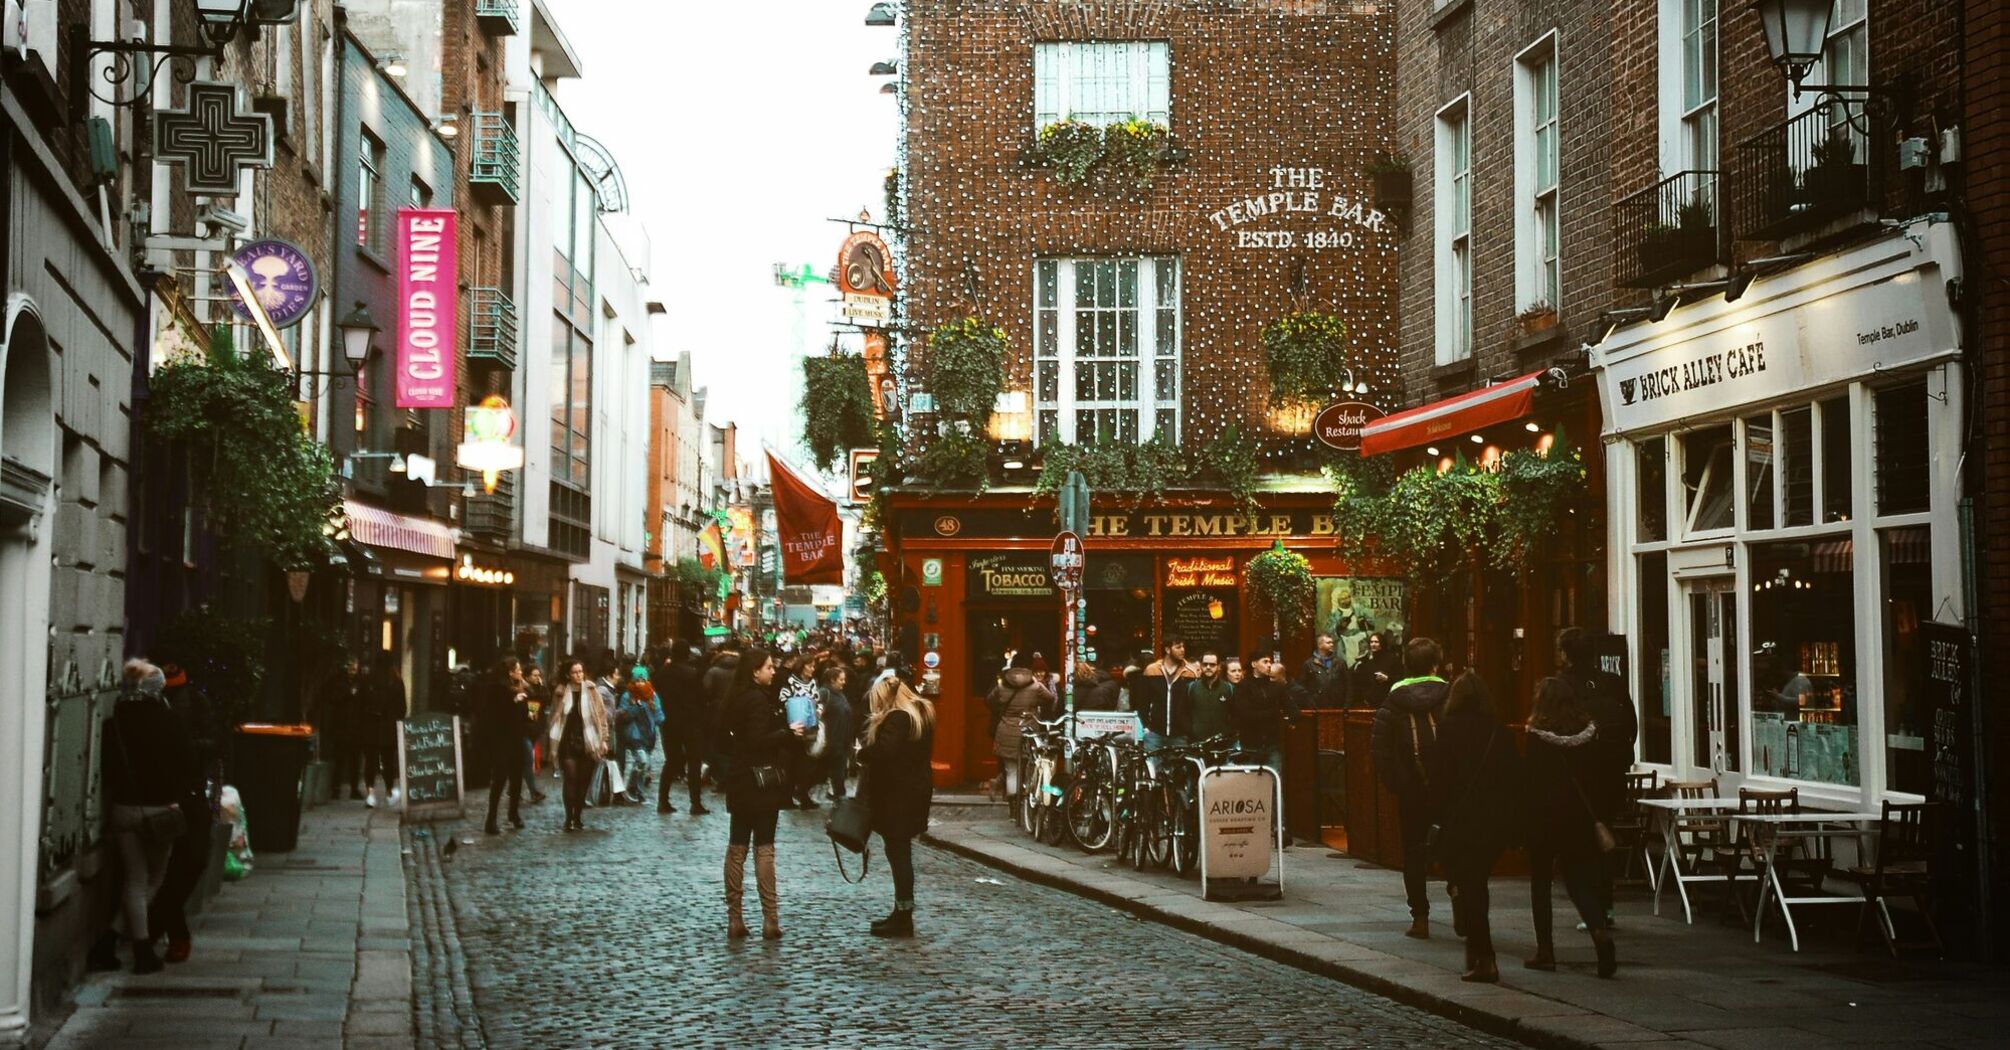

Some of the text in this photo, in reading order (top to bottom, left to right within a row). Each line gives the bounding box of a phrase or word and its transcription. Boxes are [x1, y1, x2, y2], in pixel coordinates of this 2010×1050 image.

[1269, 167, 1324, 188] THE
[1209, 191, 1386, 233] TEMPLE BAR
[1305, 231, 1353, 248] 1840
[410, 218, 445, 282] NINE
[236, 244, 309, 282] EAL'S YARD
[853, 295, 880, 304] DUBLIN
[848, 308, 884, 319] LIVE MUSIC
[408, 291, 444, 381] CLOUD
[1857, 320, 1919, 346] Temple Bar, Dublin
[1640, 334, 1767, 401] BRICK ALLEY CAFÉ
[939, 518, 955, 533] 48
[1085, 516, 1129, 536] HE
[1144, 515, 1292, 536] TEMPLE
[801, 532, 820, 540] THE
[800, 549, 825, 561] BAR
[1168, 559, 1231, 573] Traditional
[981, 570, 1046, 592] TOBACCO
[1167, 573, 1234, 587] Irish Music
[1371, 598, 1400, 610] BAR
[1930, 640, 1959, 664] BRICK
[1210, 800, 1265, 815] ARIOSA
